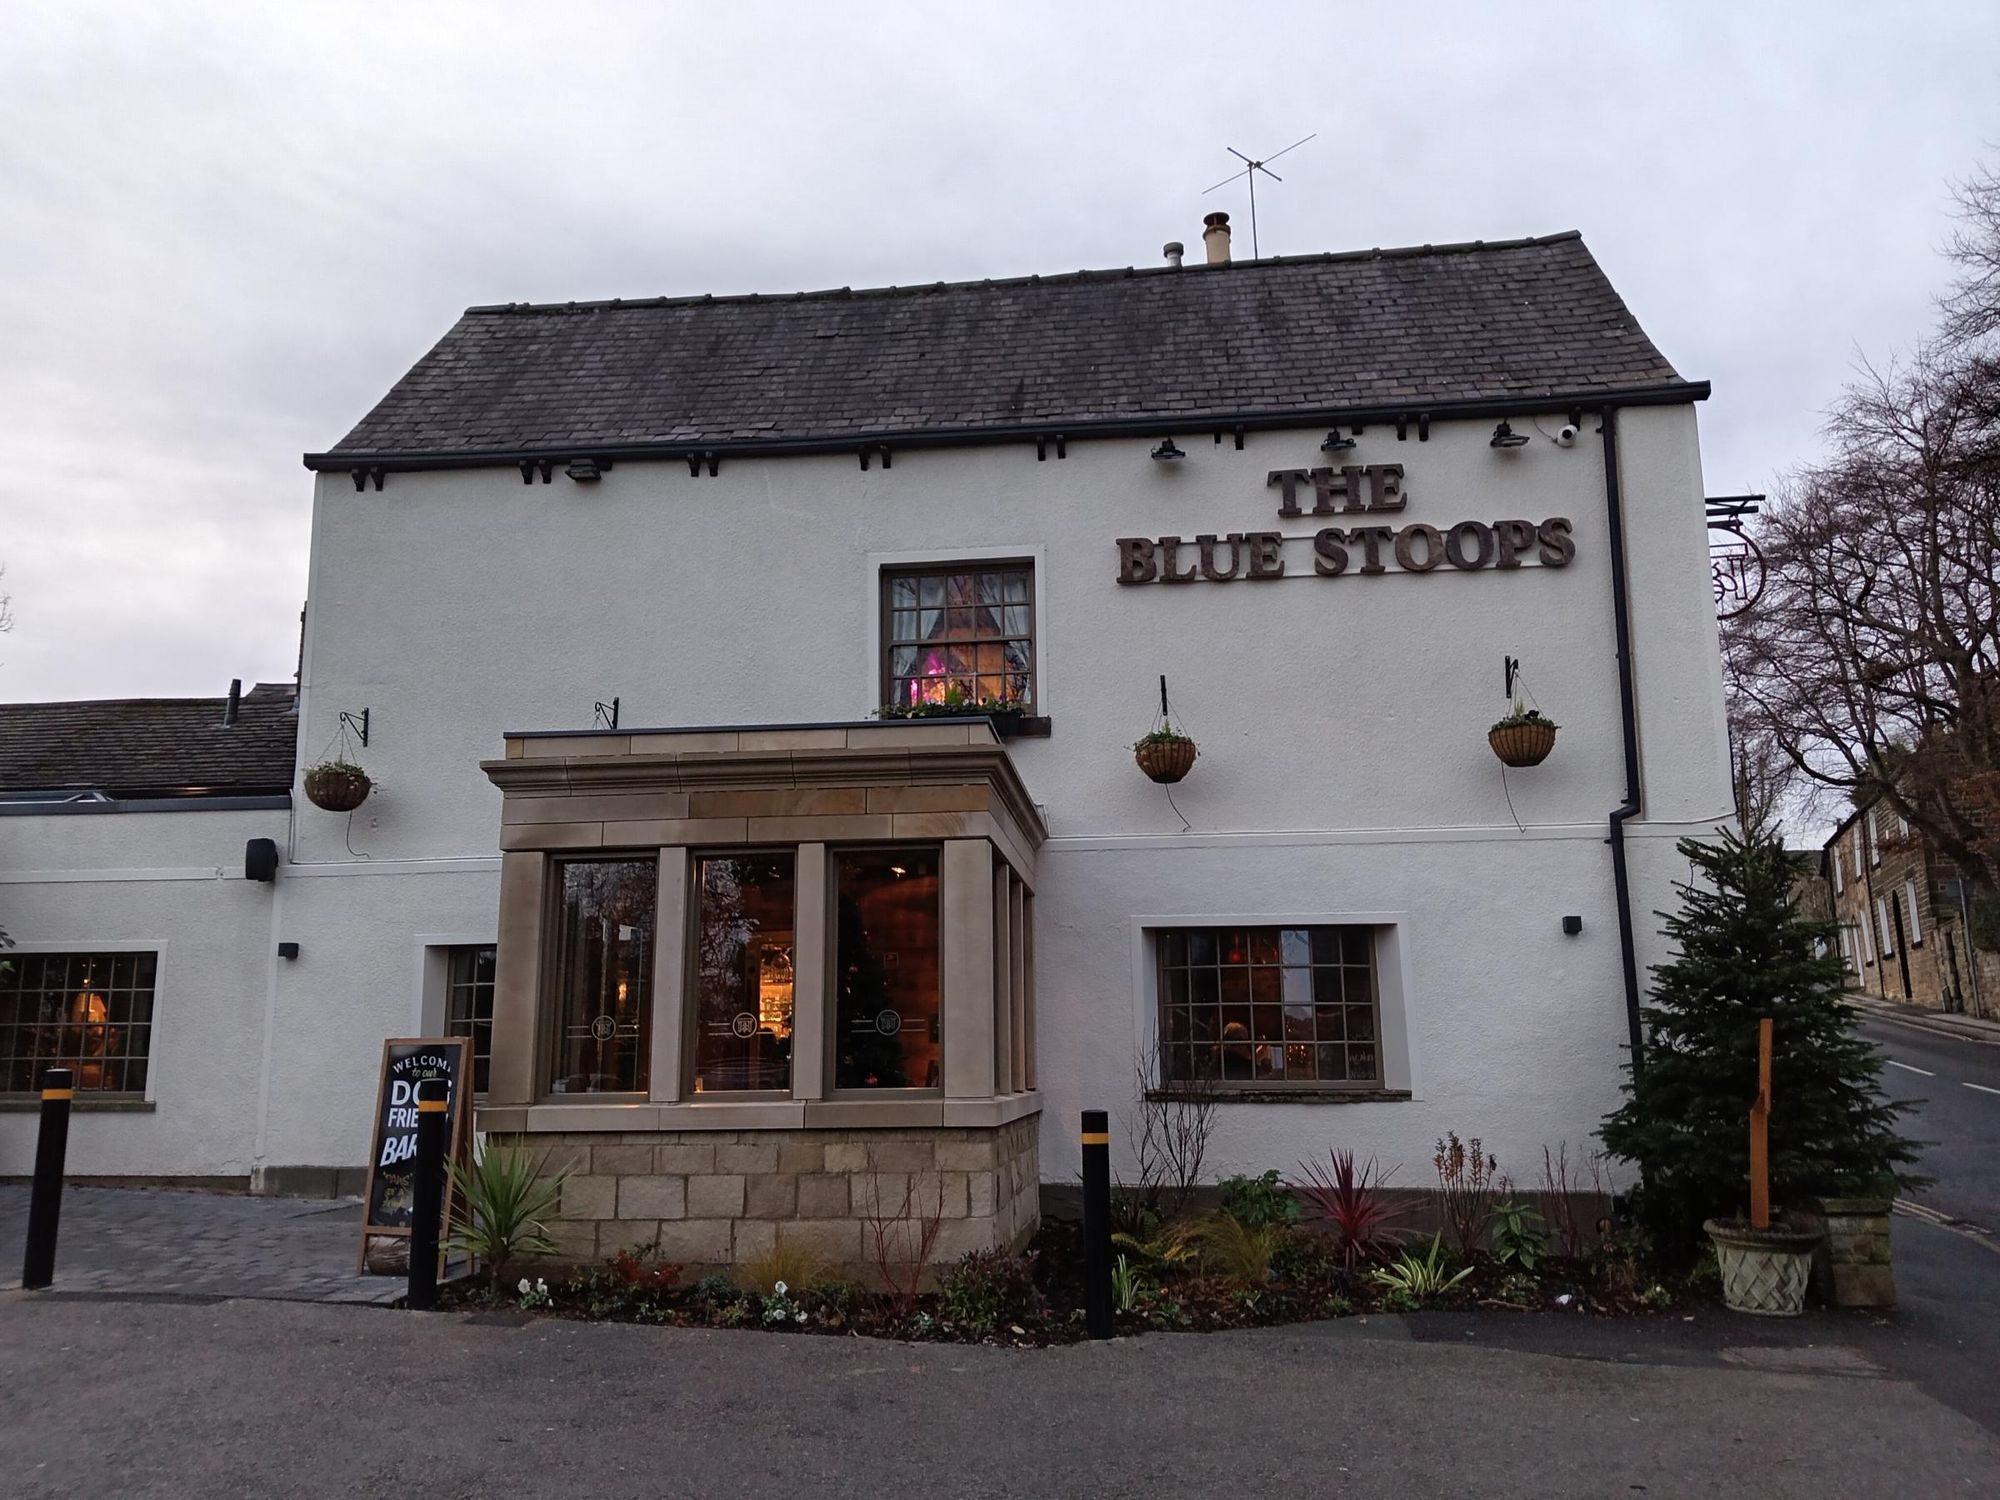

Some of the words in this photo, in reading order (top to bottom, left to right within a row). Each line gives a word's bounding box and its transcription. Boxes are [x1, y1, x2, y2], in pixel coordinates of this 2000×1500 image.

[1267, 464, 1408, 517] THE
[1116, 532, 1285, 583] BLUE
[1314, 517, 1576, 576] STOOPS
